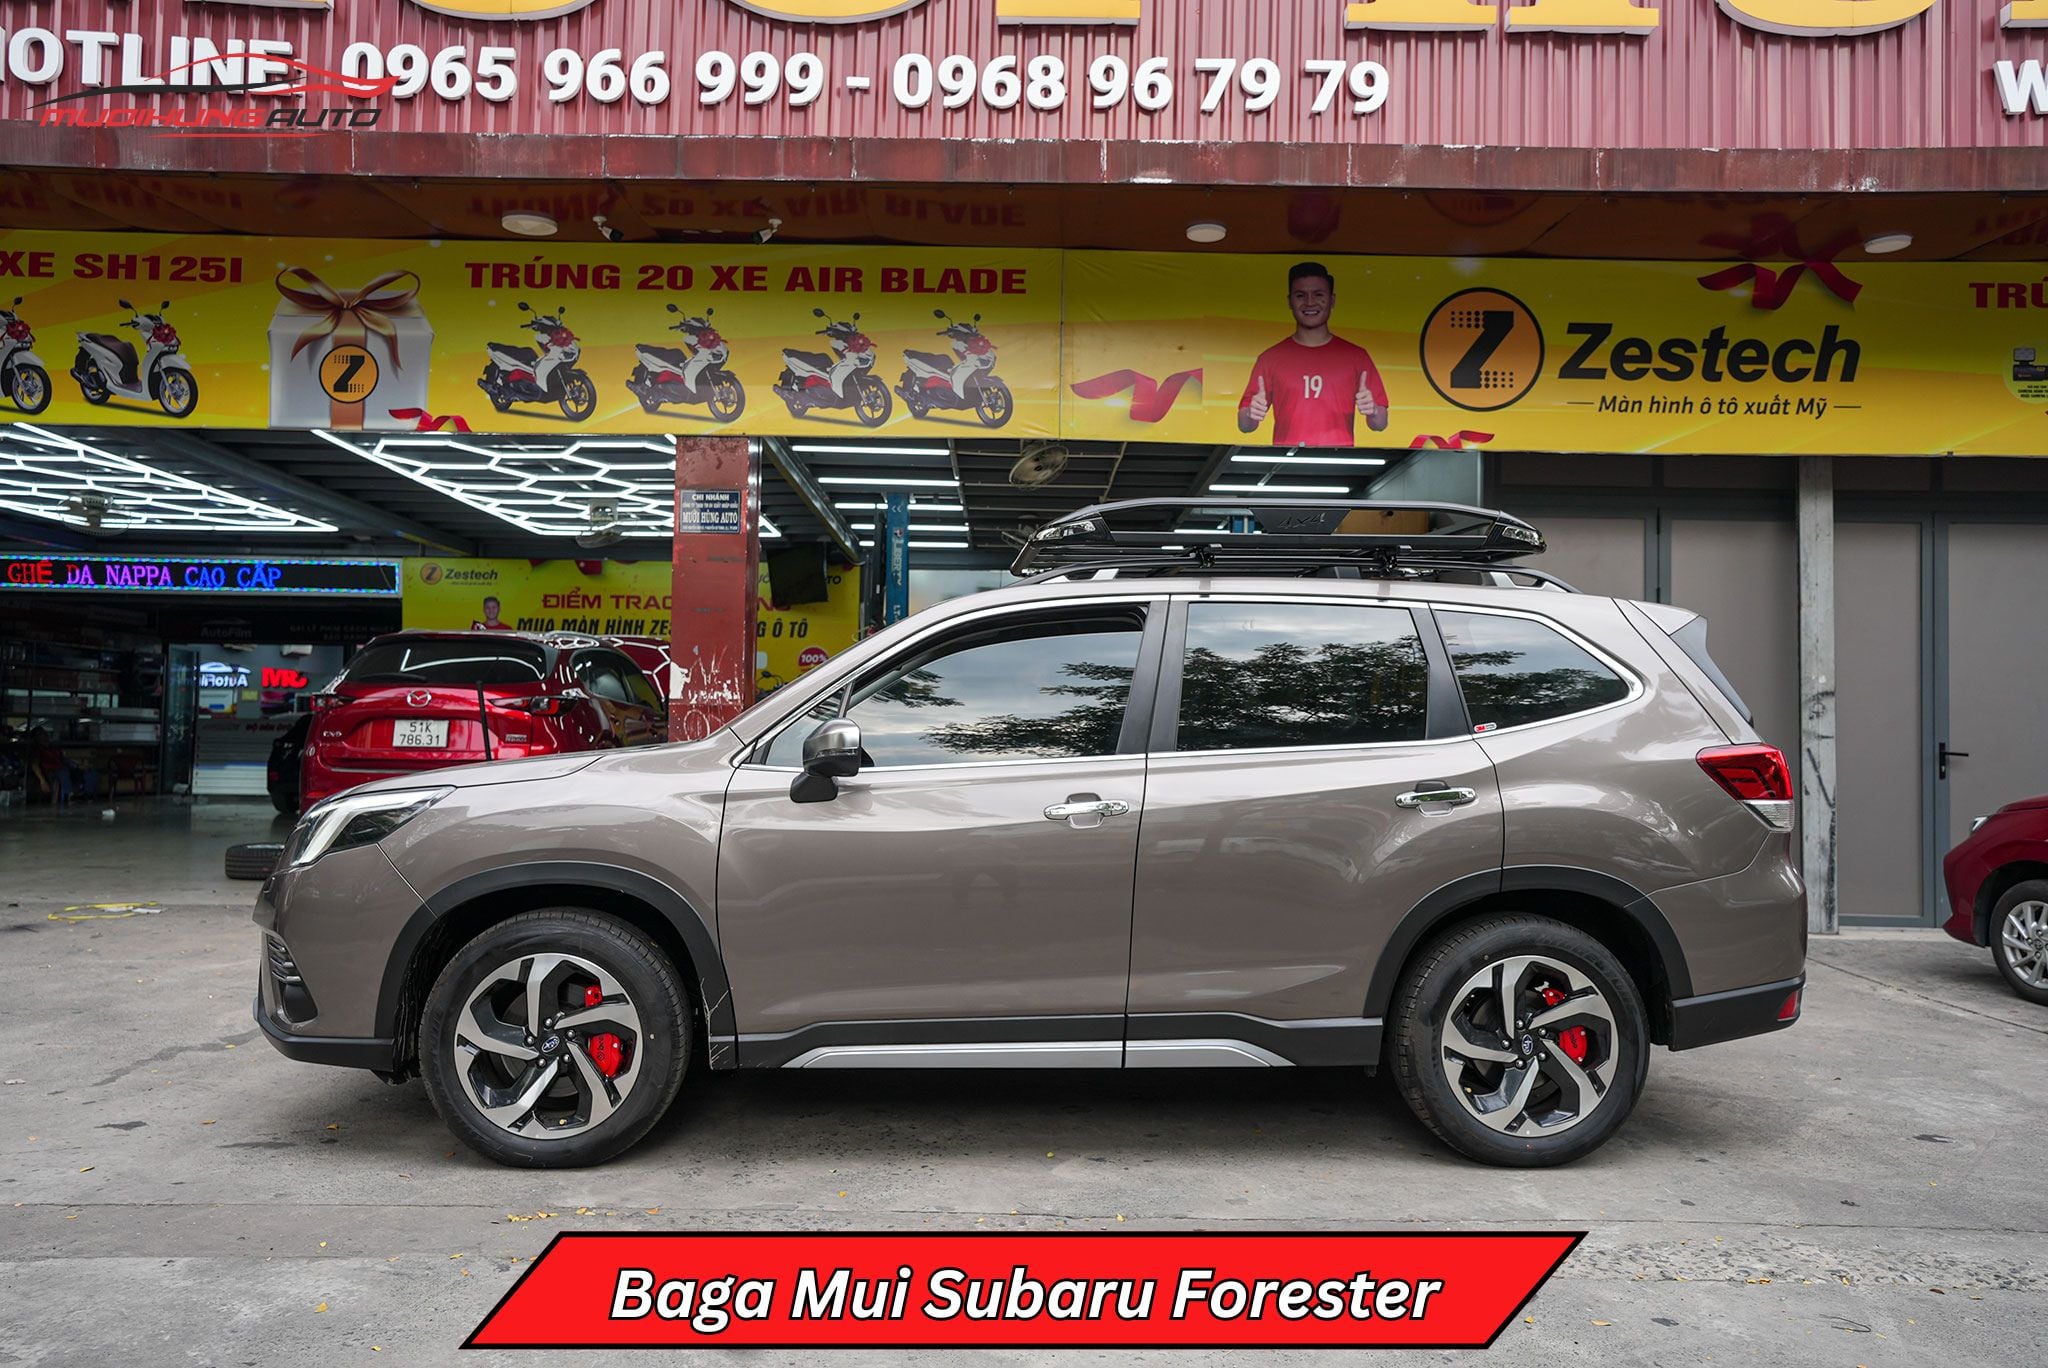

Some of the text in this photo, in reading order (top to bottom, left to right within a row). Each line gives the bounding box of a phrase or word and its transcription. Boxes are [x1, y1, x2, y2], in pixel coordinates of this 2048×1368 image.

[0, 26, 307, 97] OTLINE:
[341, 41, 517, 102] 0965
[544, 47, 671, 104] 966
[696, 49, 824, 107] 999
[892, 52, 1066, 110] 0968
[1089, 54, 1173, 113] 96
[1195, 57, 1281, 114] 79
[1305, 59, 1389, 115] 79
[0, 251, 244, 284] XE SH125I
[465, 255, 1027, 295] TRÚNG 20 XE AIR BLADE
[1558, 322, 1861, 383] Zestech
[1302, 375, 1323, 399] 19
[1598, 393, 1828, 420] Màn hình ô tô xuất Mỹ
[66, 564, 95, 585] DA
[105, 564, 174, 587] NAPPA
[184, 565, 226, 588] CAO
[444, 568, 498, 580] Zestech
[542, 587, 603, 610] ĐIỂM
[605, 615, 645, 636] HÌNH
[772, 618, 783, 638] Ô
[789, 618, 809, 638] TÔ
[409, 721, 432, 733] 51K
[399, 733, 441, 746] 786.31
